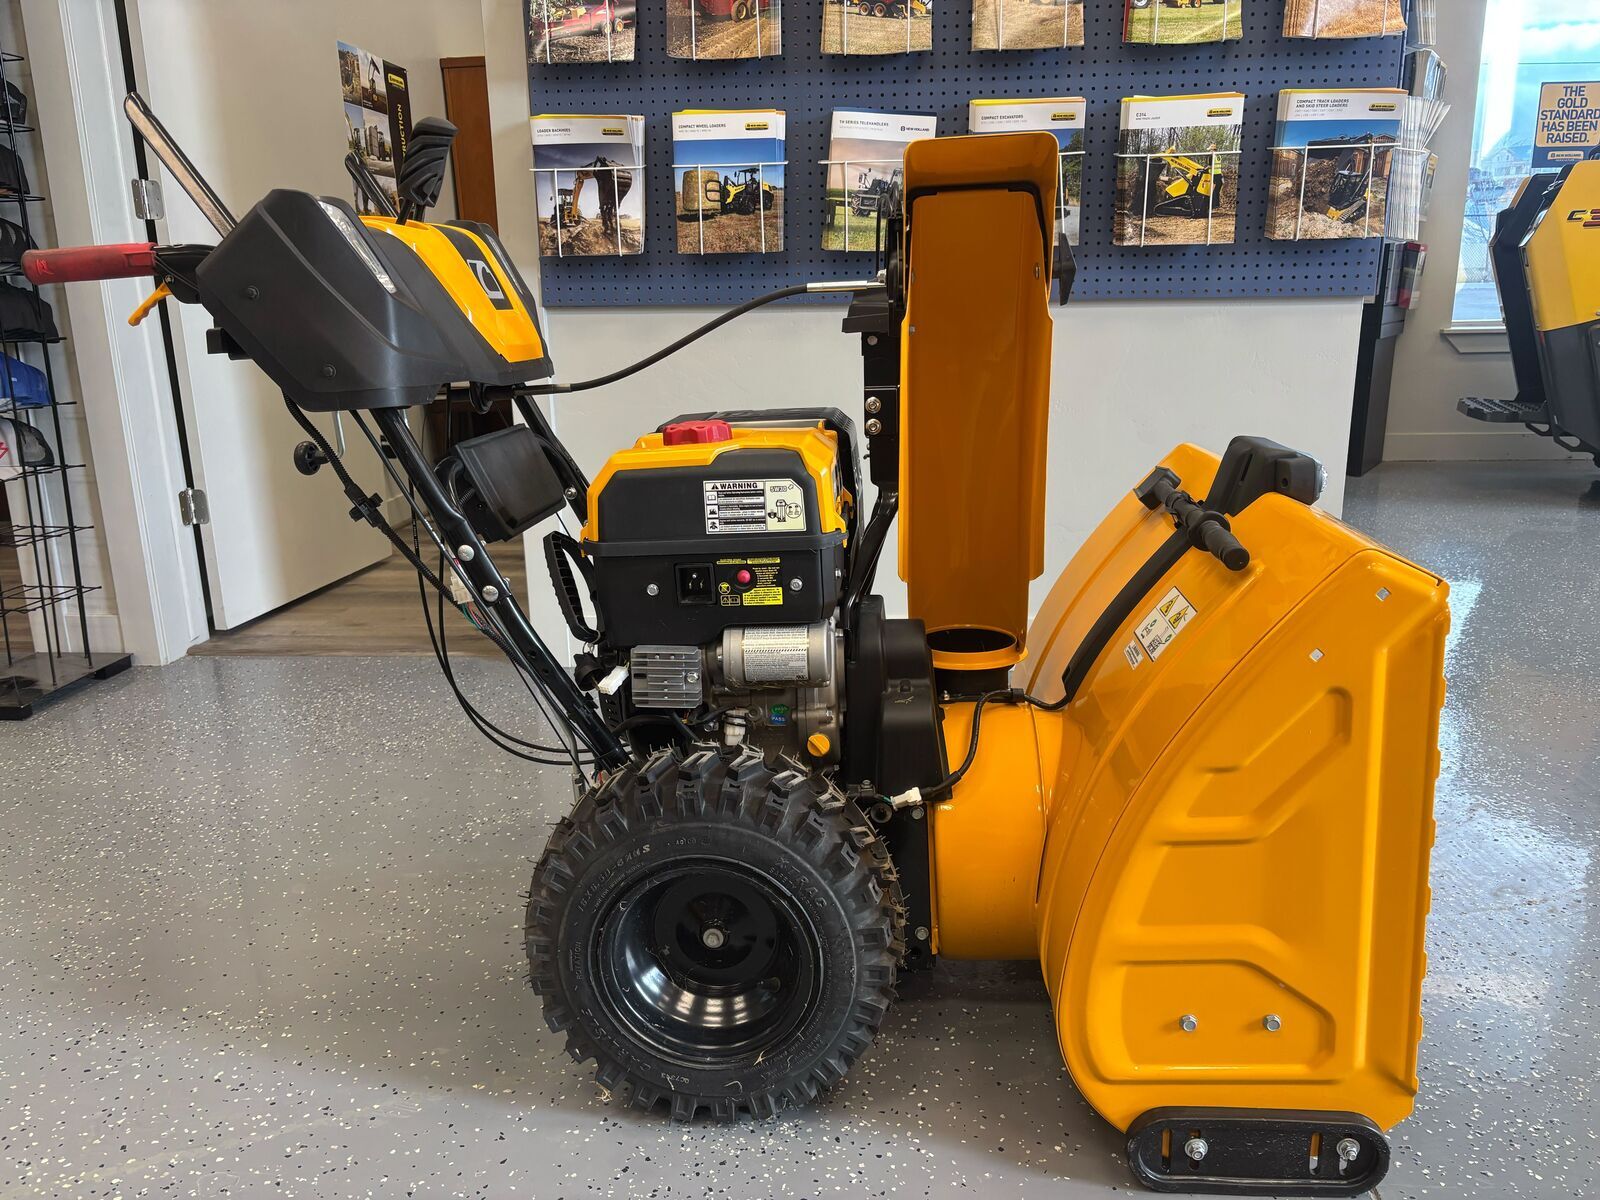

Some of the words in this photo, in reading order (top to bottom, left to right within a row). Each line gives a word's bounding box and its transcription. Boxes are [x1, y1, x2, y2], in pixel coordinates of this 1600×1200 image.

[1563, 86, 1586, 97] THE
[1557, 97, 1588, 108] GOLD
[1540, 109, 1600, 120] STANDARD
[1541, 121, 1564, 132] HAS
[1566, 120, 1598, 131] BEEN
[1546, 132, 1590, 143] RAISED.
[719, 482, 758, 490] WARNING
[574, 941, 583, 980] ROTATION
